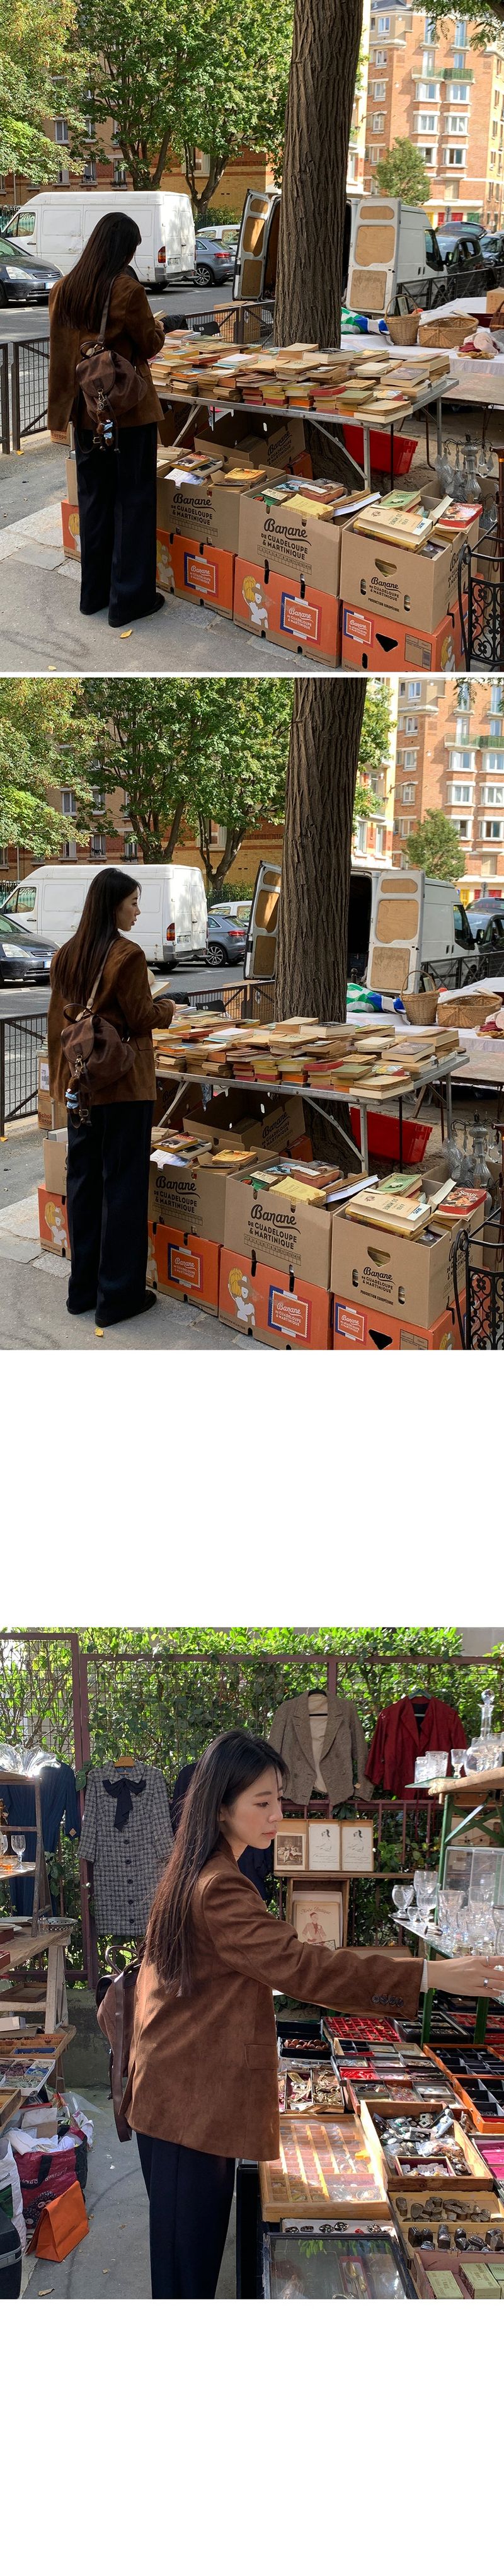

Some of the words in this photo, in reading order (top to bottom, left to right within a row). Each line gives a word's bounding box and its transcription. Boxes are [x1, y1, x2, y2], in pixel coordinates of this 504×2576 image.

[268, 431, 292, 456] Banane
[173, 493, 215, 512] Banane
[177, 505, 212, 520] GUADELOUPE
[177, 511, 210, 526] MARTINIQUE
[264, 518, 312, 547] Banane
[267, 541, 305, 561] MARTINIQUE
[268, 535, 307, 555] GUADELOUPE
[191, 565, 212, 578] Banane
[371, 577, 401, 594] Banane
[374, 586, 399, 598] GUADELOUPE
[374, 590, 398, 601] MARTINIQUE
[289, 607, 314, 623] Banane
[350, 619, 368, 630] Banane
[262, 1112, 290, 1138] Banane
[156, 1176, 200, 1199] Banane
[160, 1191, 197, 1207] GUADELOUPE
[160, 1199, 195, 1213] MARTINIQUE
[251, 1204, 301, 1234] Banane
[255, 1222, 297, 1243] GUADELOUPE
[255, 1230, 294, 1250] MARTINIQUE
[175, 1258, 197, 1271] Banane
[364, 1267, 396, 1285] Banane
[366, 1277, 393, 1290] GUADELOUPE
[366, 1281, 391, 1293] MARTINIQUE
[277, 1302, 303, 1319] Banane
[341, 1315, 360, 1328] Banane
